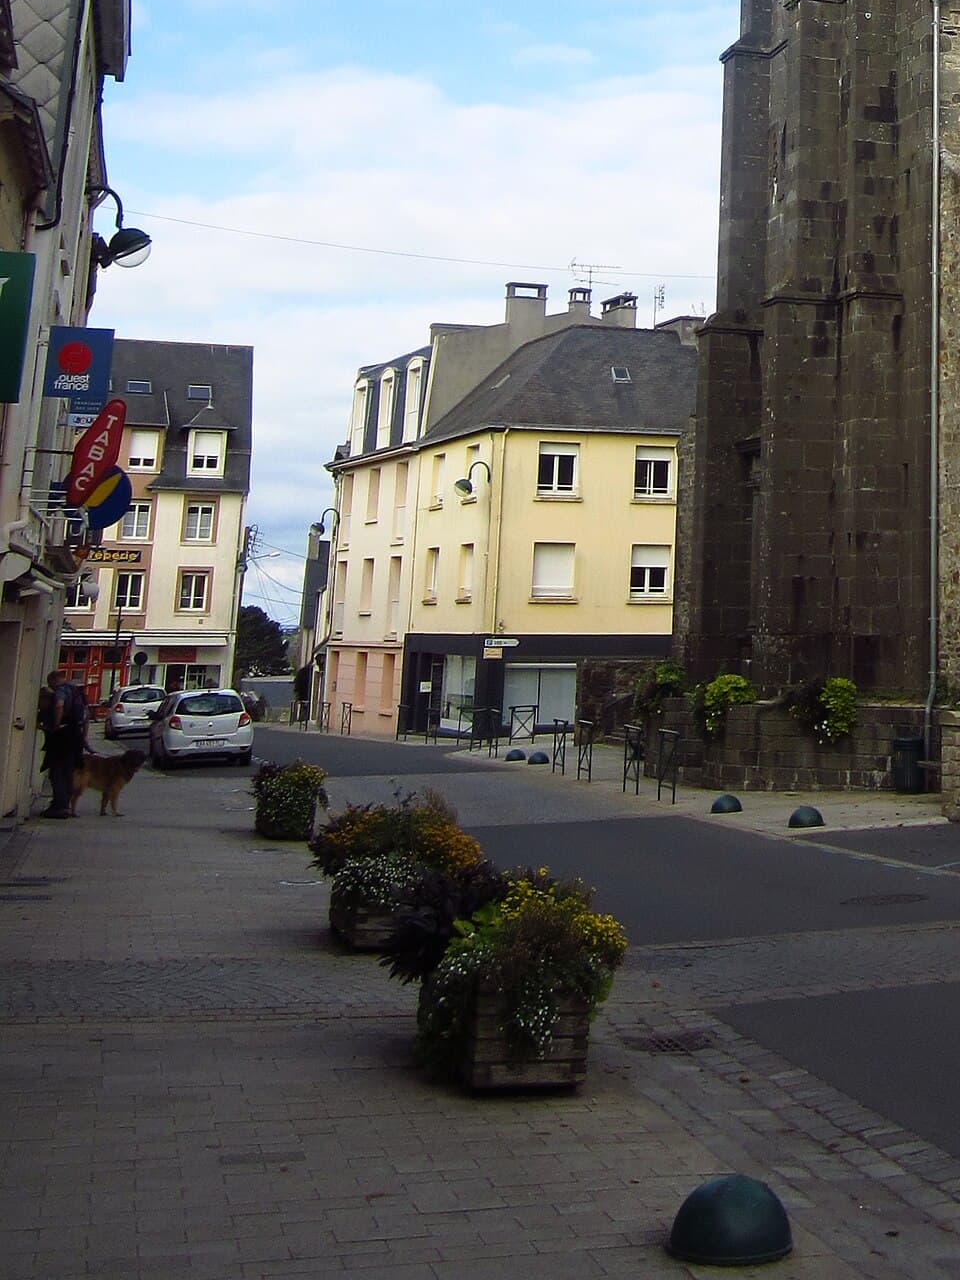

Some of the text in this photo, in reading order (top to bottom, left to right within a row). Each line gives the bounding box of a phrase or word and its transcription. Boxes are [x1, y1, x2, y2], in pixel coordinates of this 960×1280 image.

[59, 374, 90, 383] ouest
[54, 381, 89, 391] france
[75, 414, 118, 491] TABAC
[88, 549, 138, 561] rêperie
